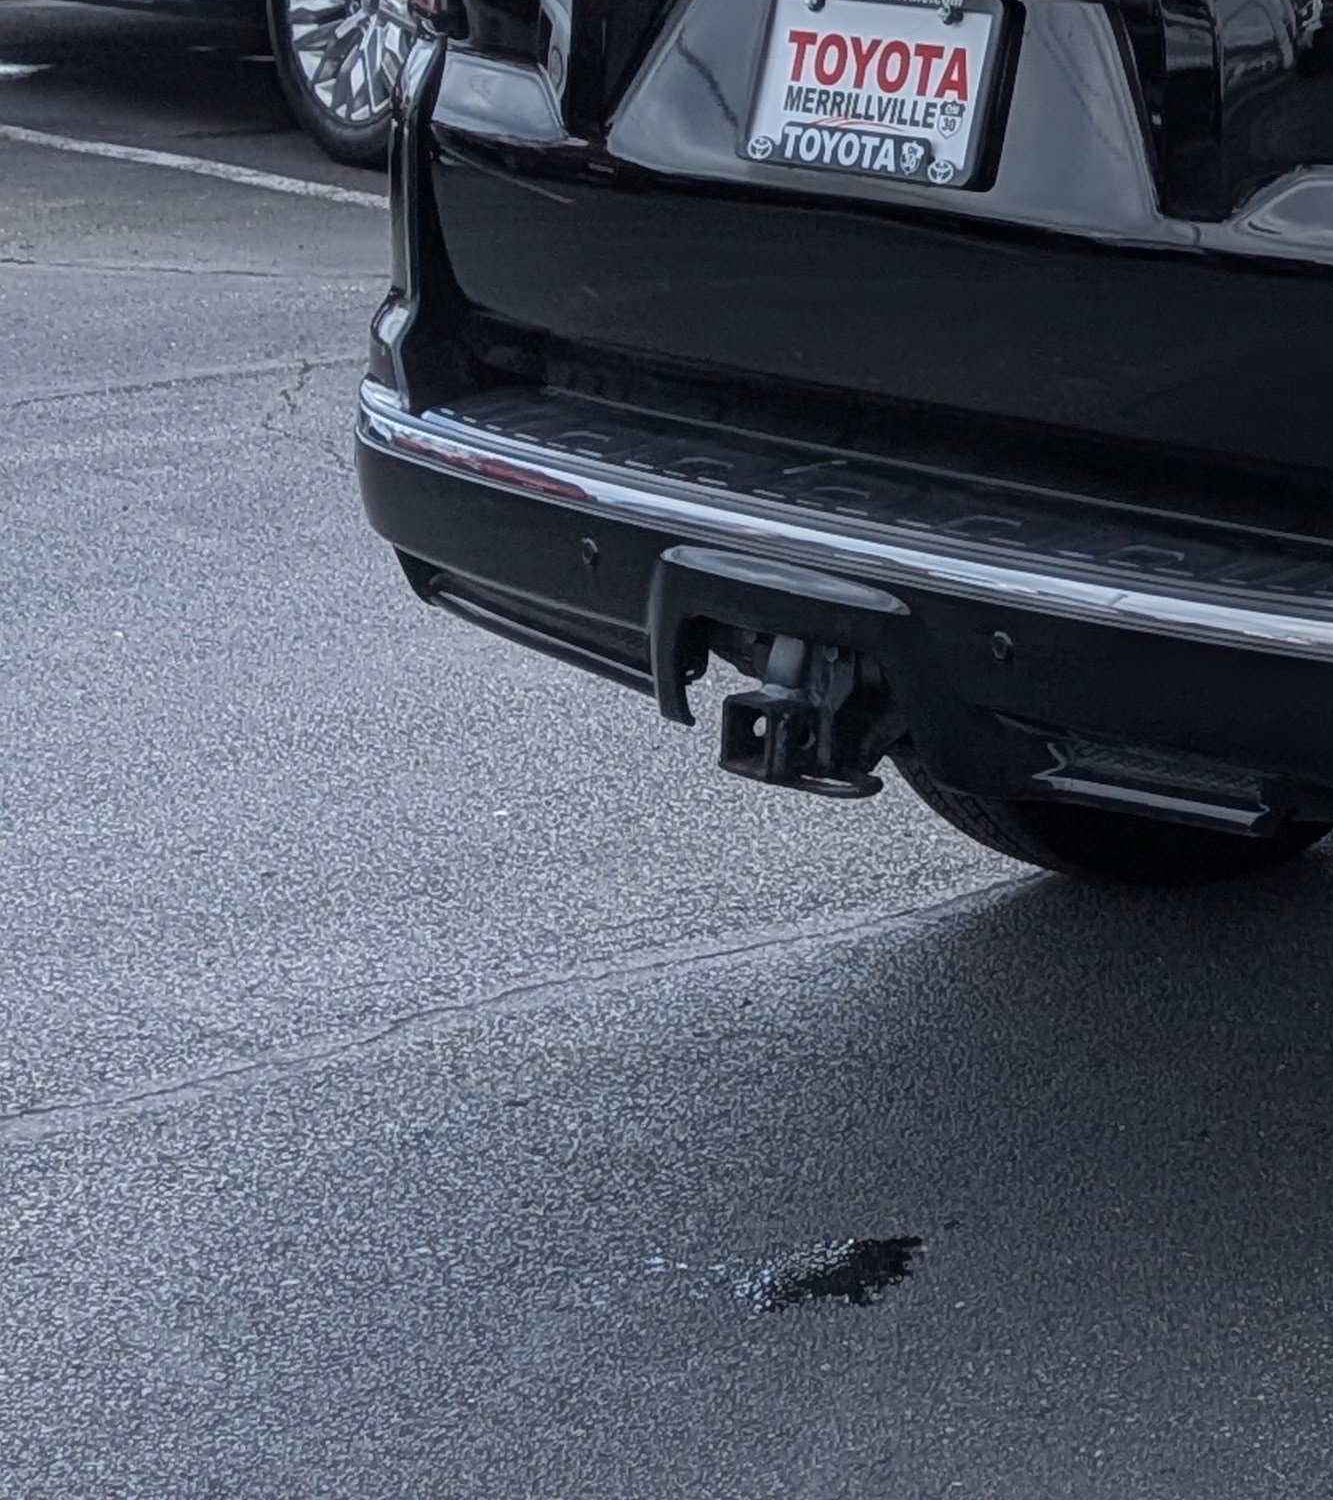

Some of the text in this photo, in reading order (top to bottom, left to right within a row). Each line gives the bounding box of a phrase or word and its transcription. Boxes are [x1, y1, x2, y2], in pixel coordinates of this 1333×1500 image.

[788, 30, 968, 101] TOYOTA
[783, 85, 938, 129] MERRILLVILLE
[941, 117, 957, 132] 30
[784, 126, 896, 172] TOYOTA
